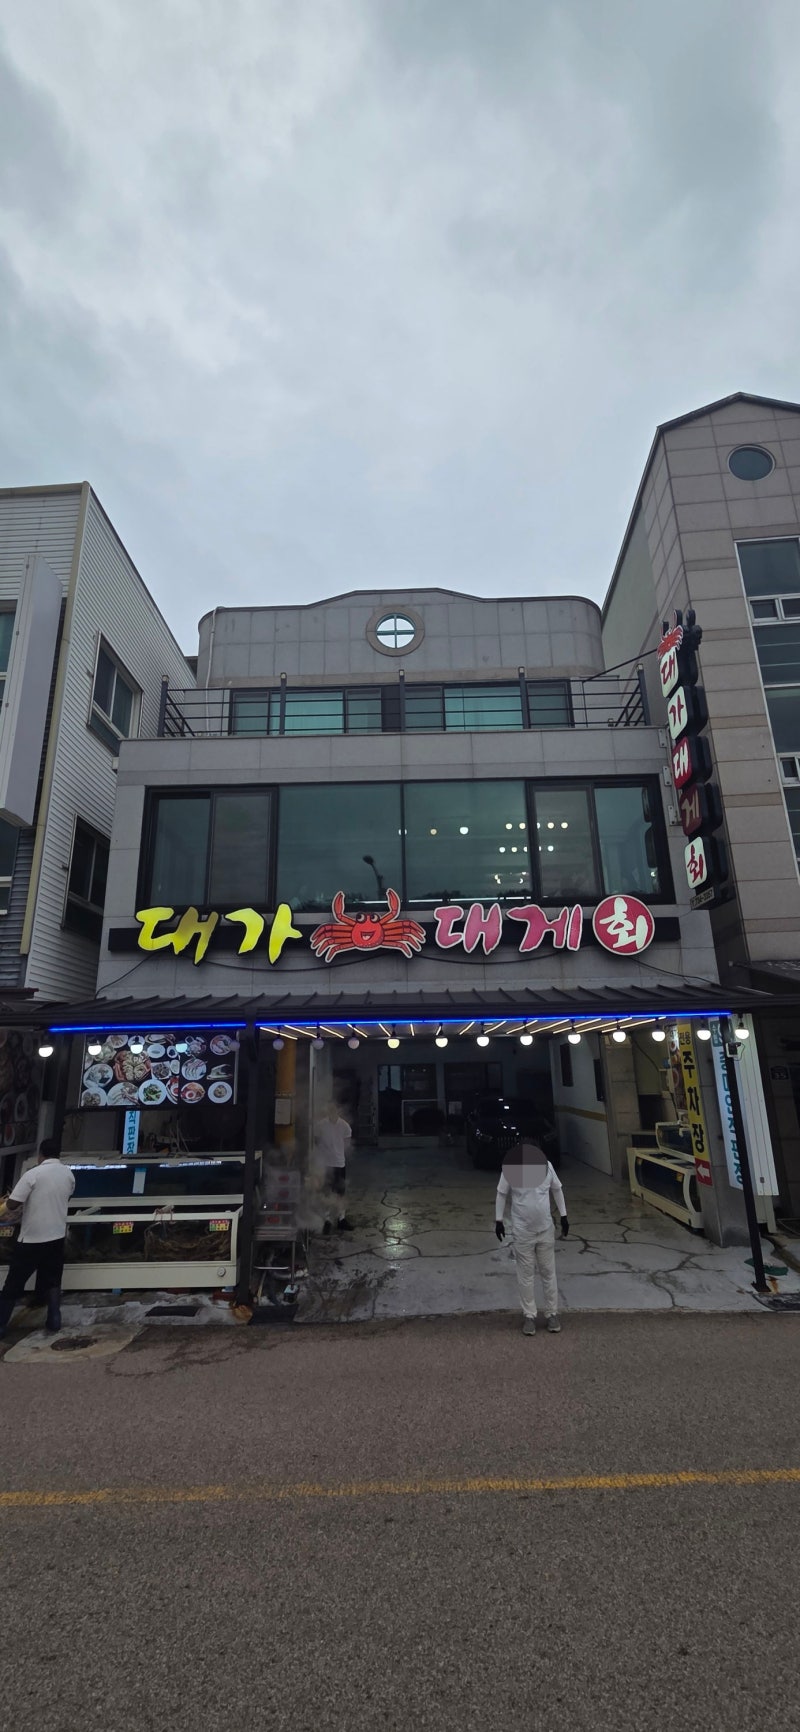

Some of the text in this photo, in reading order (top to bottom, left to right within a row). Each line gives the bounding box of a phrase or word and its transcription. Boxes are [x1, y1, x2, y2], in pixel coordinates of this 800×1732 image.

[136, 897, 649, 966] 대가 대게 회
[683, 1051, 705, 1153] 주차장
